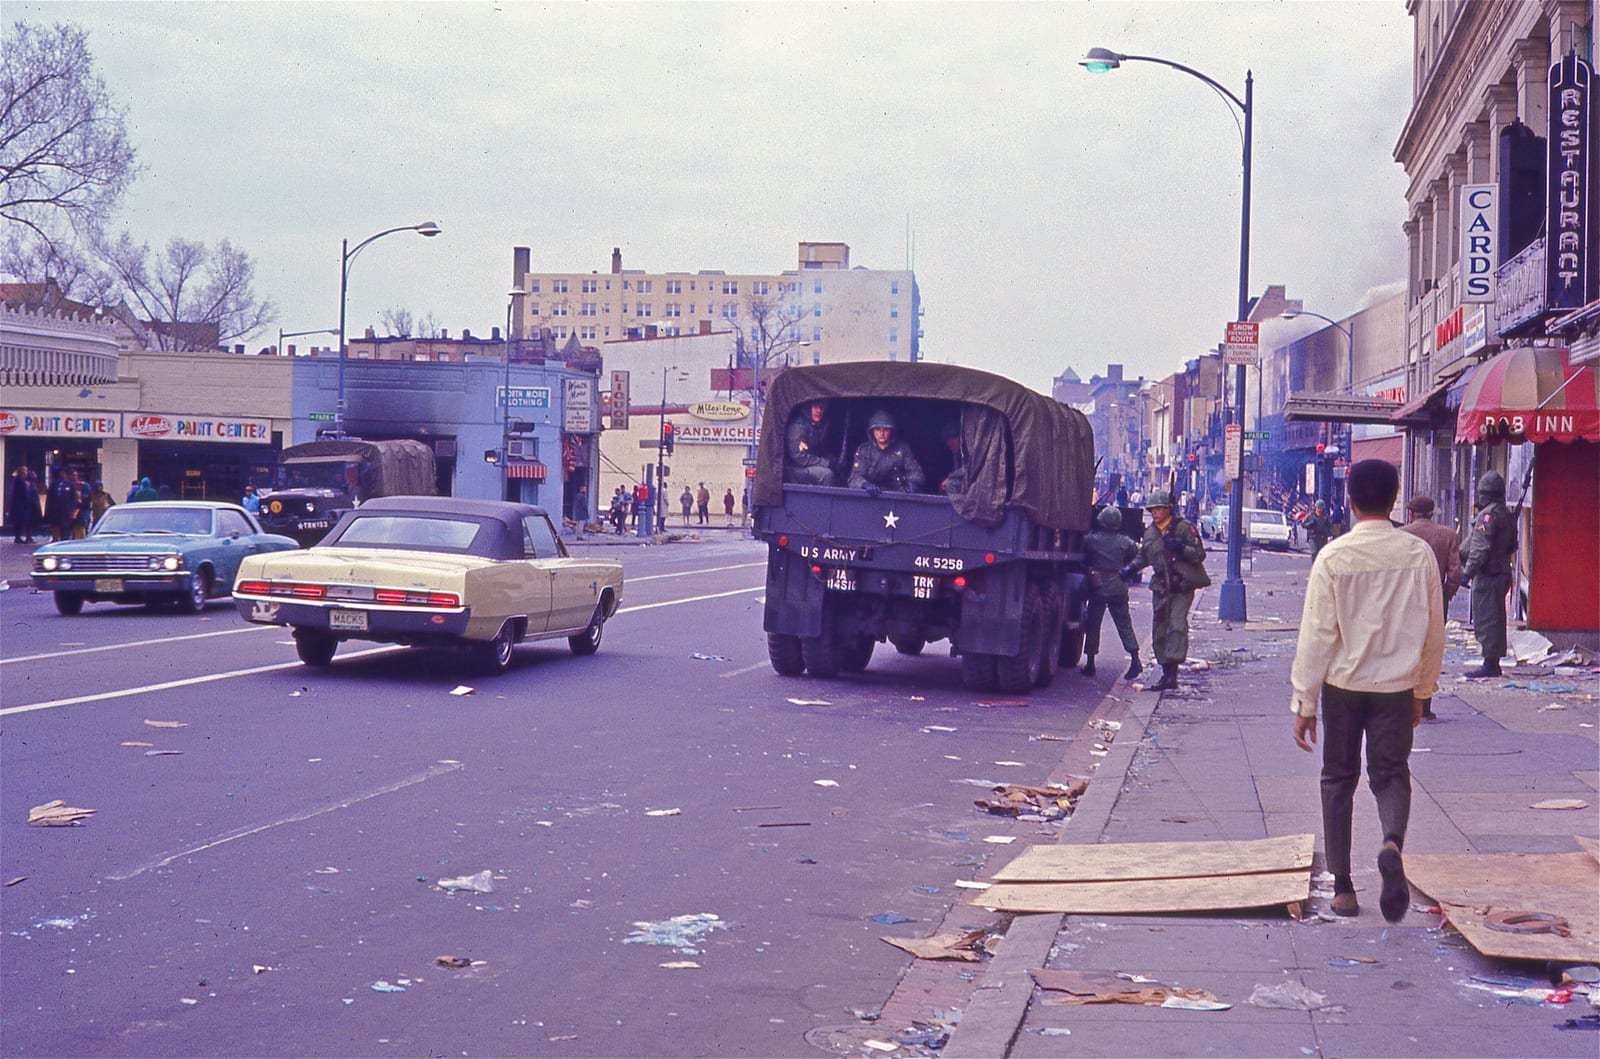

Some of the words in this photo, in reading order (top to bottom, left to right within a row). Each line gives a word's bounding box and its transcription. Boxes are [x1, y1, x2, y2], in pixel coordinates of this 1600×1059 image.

[1559, 88, 1581, 288] RESTAURANT
[1467, 191, 1492, 296] CARDS
[526, 390, 547, 398] MORE
[614, 374, 624, 427] LIQUOR
[24, 416, 61, 432] PAINT
[64, 416, 115, 433] CENTER
[177, 420, 213, 436] PAINT
[216, 422, 266, 438] CENTER
[1535, 415, 1573, 432] INN
[674, 427, 762, 438] SANDWICHES
[801, 546, 808, 557] U
[812, 547, 819, 558] S
[823, 548, 856, 561] ARMY
[914, 556, 930, 568] 4K
[933, 557, 963, 571] 5258
[913, 576, 934, 588] TRK
[914, 587, 931, 599] 161
[333, 614, 364, 625] MACKS
